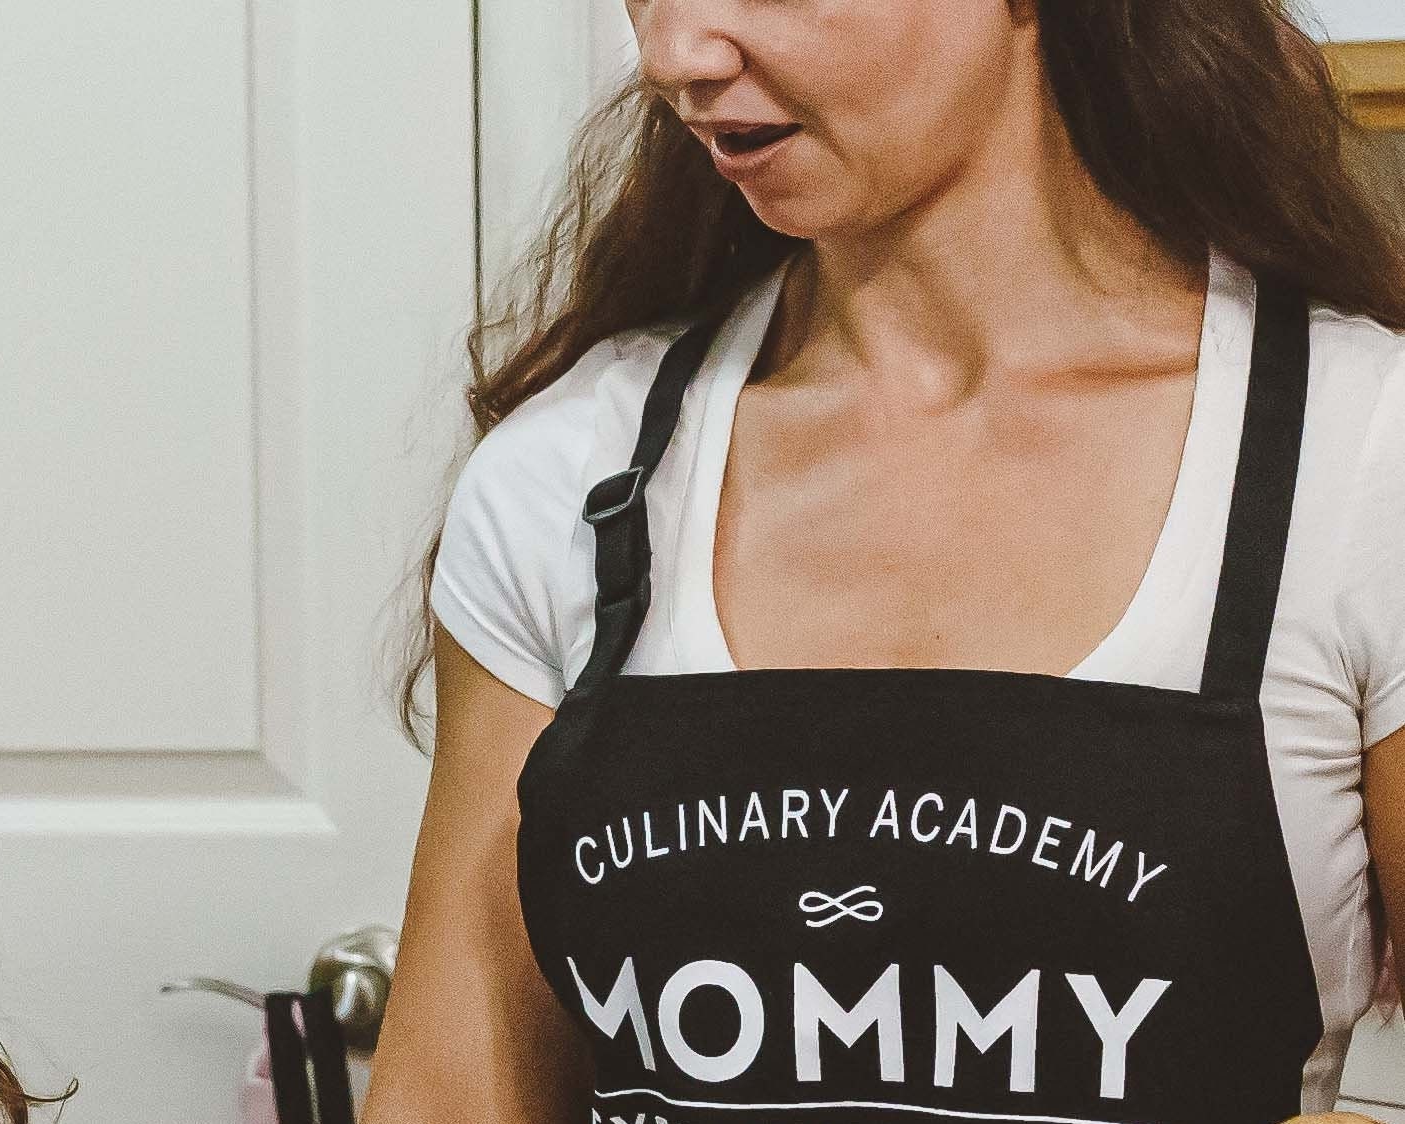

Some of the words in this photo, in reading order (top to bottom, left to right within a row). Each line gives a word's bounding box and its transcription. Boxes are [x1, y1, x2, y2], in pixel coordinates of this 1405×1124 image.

[575, 788, 849, 885] CULINARY
[869, 789, 1168, 903] ACADEMY
[566, 957, 1173, 1100] MOMMY
